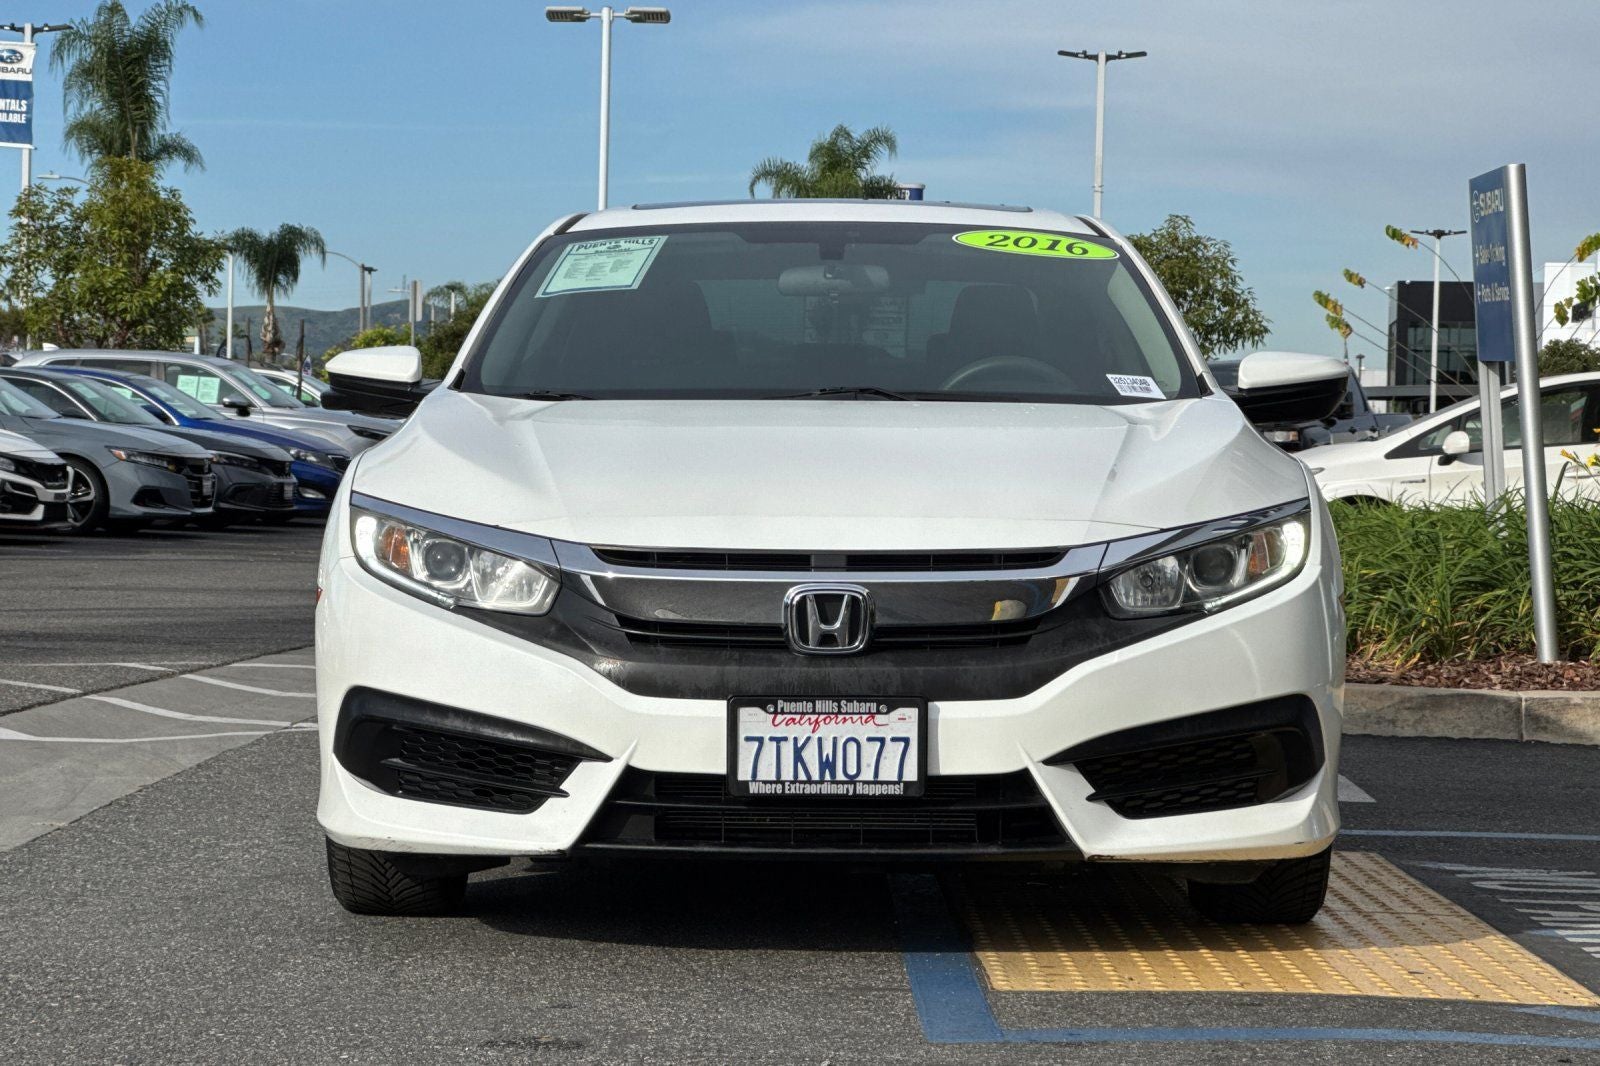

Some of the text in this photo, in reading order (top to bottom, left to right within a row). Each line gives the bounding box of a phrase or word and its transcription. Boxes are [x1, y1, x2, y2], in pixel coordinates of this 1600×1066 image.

[0, 66, 32, 75] BARU
[1480, 187, 1504, 217] SUBARU
[624, 238, 656, 246] HILLS
[985, 234, 1089, 256] 2016
[1495, 282, 1510, 302] Service
[777, 699, 877, 714] Puente Hills Subaru
[771, 713, 889, 734] California
[743, 735, 911, 782] 7TKW077
[749, 782, 904, 796] Where Extraordinary Happens!
